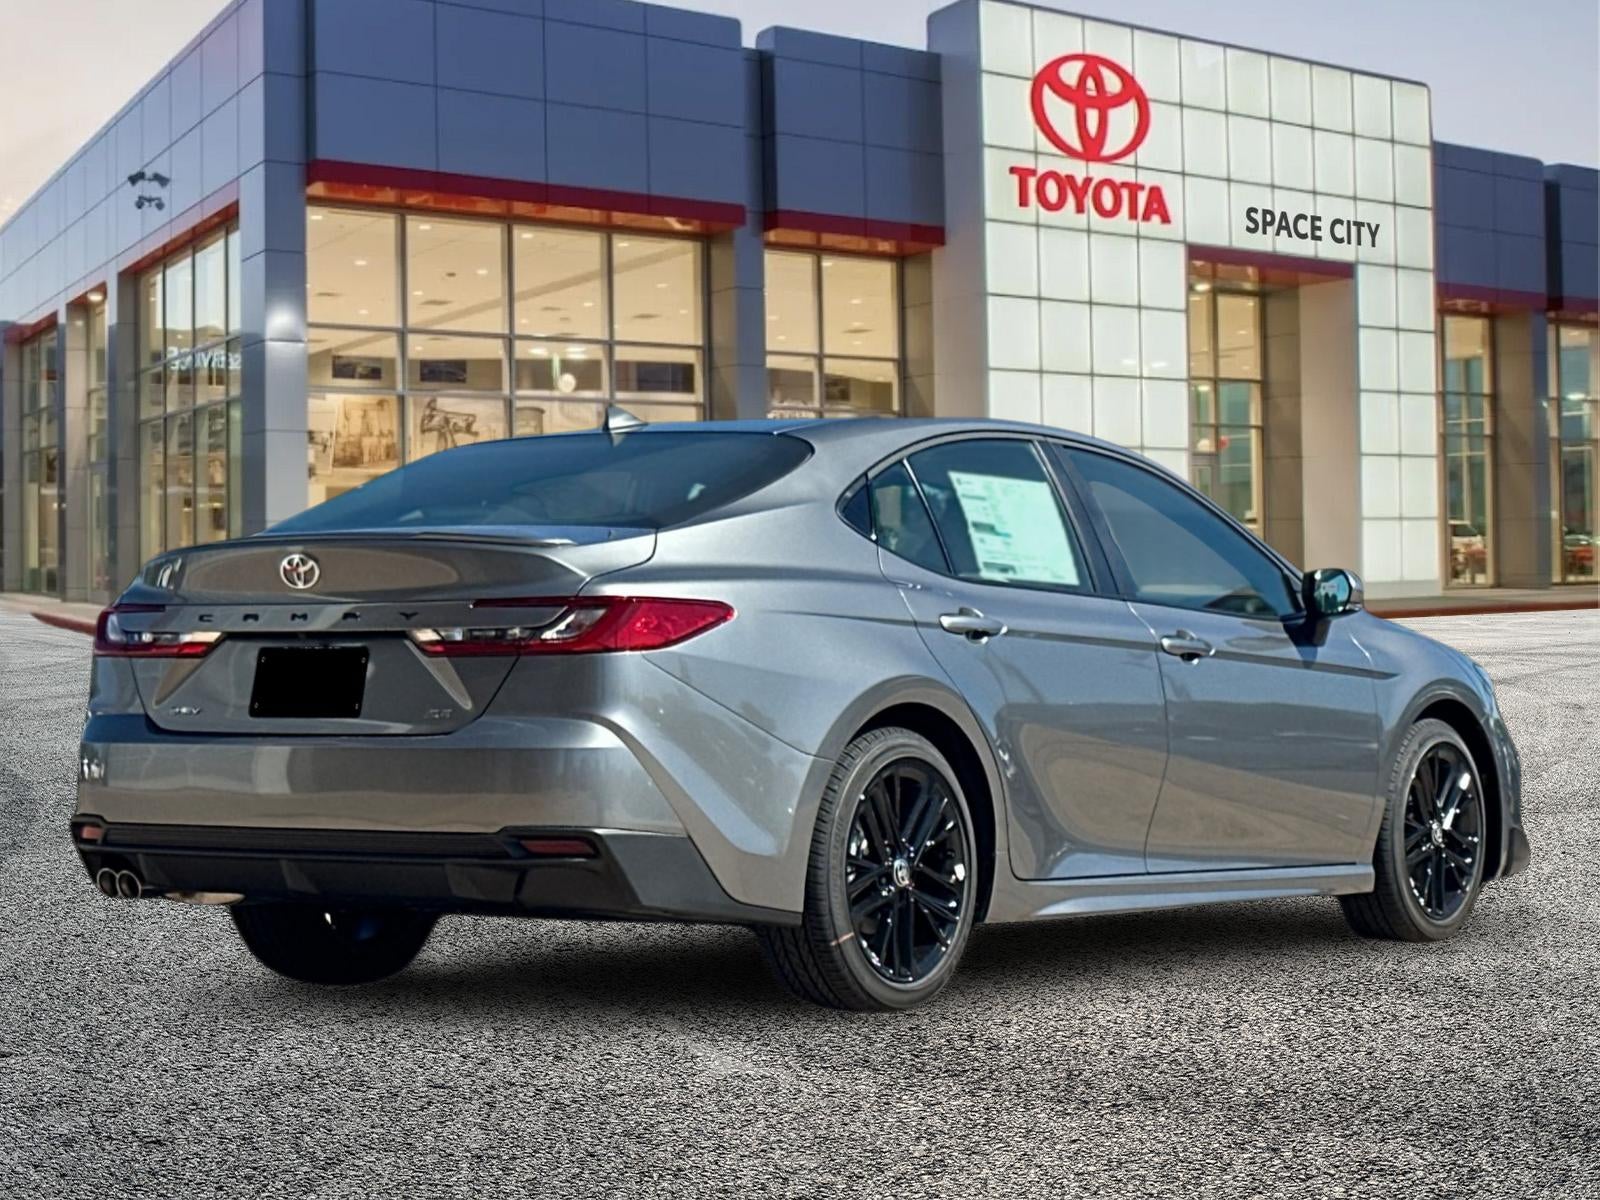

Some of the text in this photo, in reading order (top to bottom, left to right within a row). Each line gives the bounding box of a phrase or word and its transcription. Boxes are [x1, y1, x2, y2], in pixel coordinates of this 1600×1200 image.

[1009, 166, 1171, 224] TOYOTA
[1245, 206, 1381, 248] SPACE CITY
[198, 610, 419, 624] CAMRY
